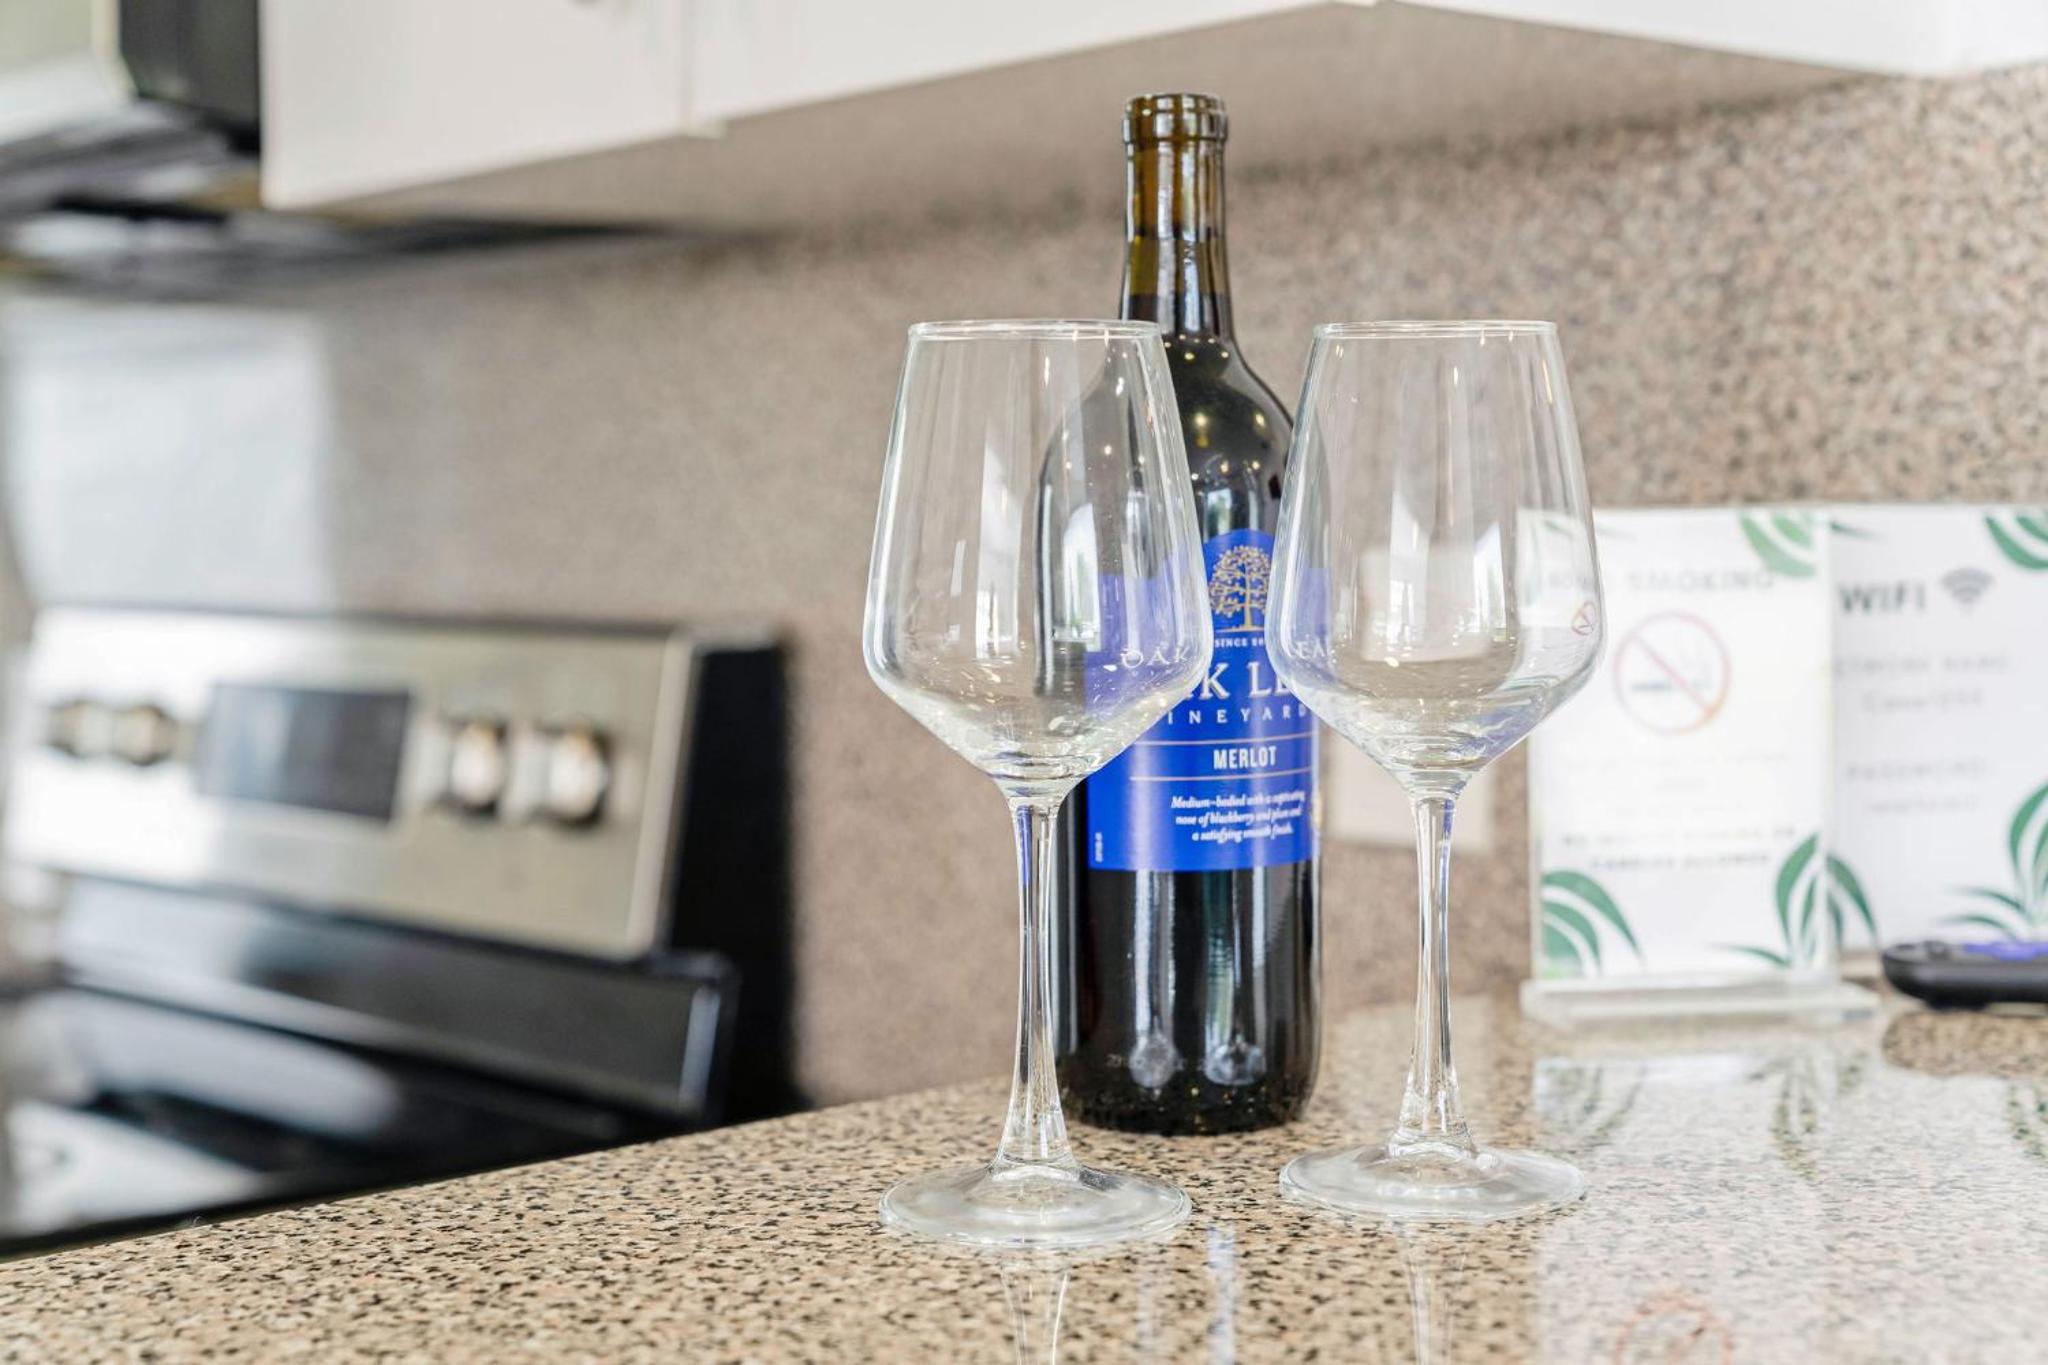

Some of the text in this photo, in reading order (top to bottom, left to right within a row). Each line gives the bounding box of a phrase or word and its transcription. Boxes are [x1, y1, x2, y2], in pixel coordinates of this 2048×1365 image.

[1838, 581, 1925, 614] WIFI
[1214, 638, 1249, 649] SINCE
[1213, 746, 1277, 770] MERLOT
